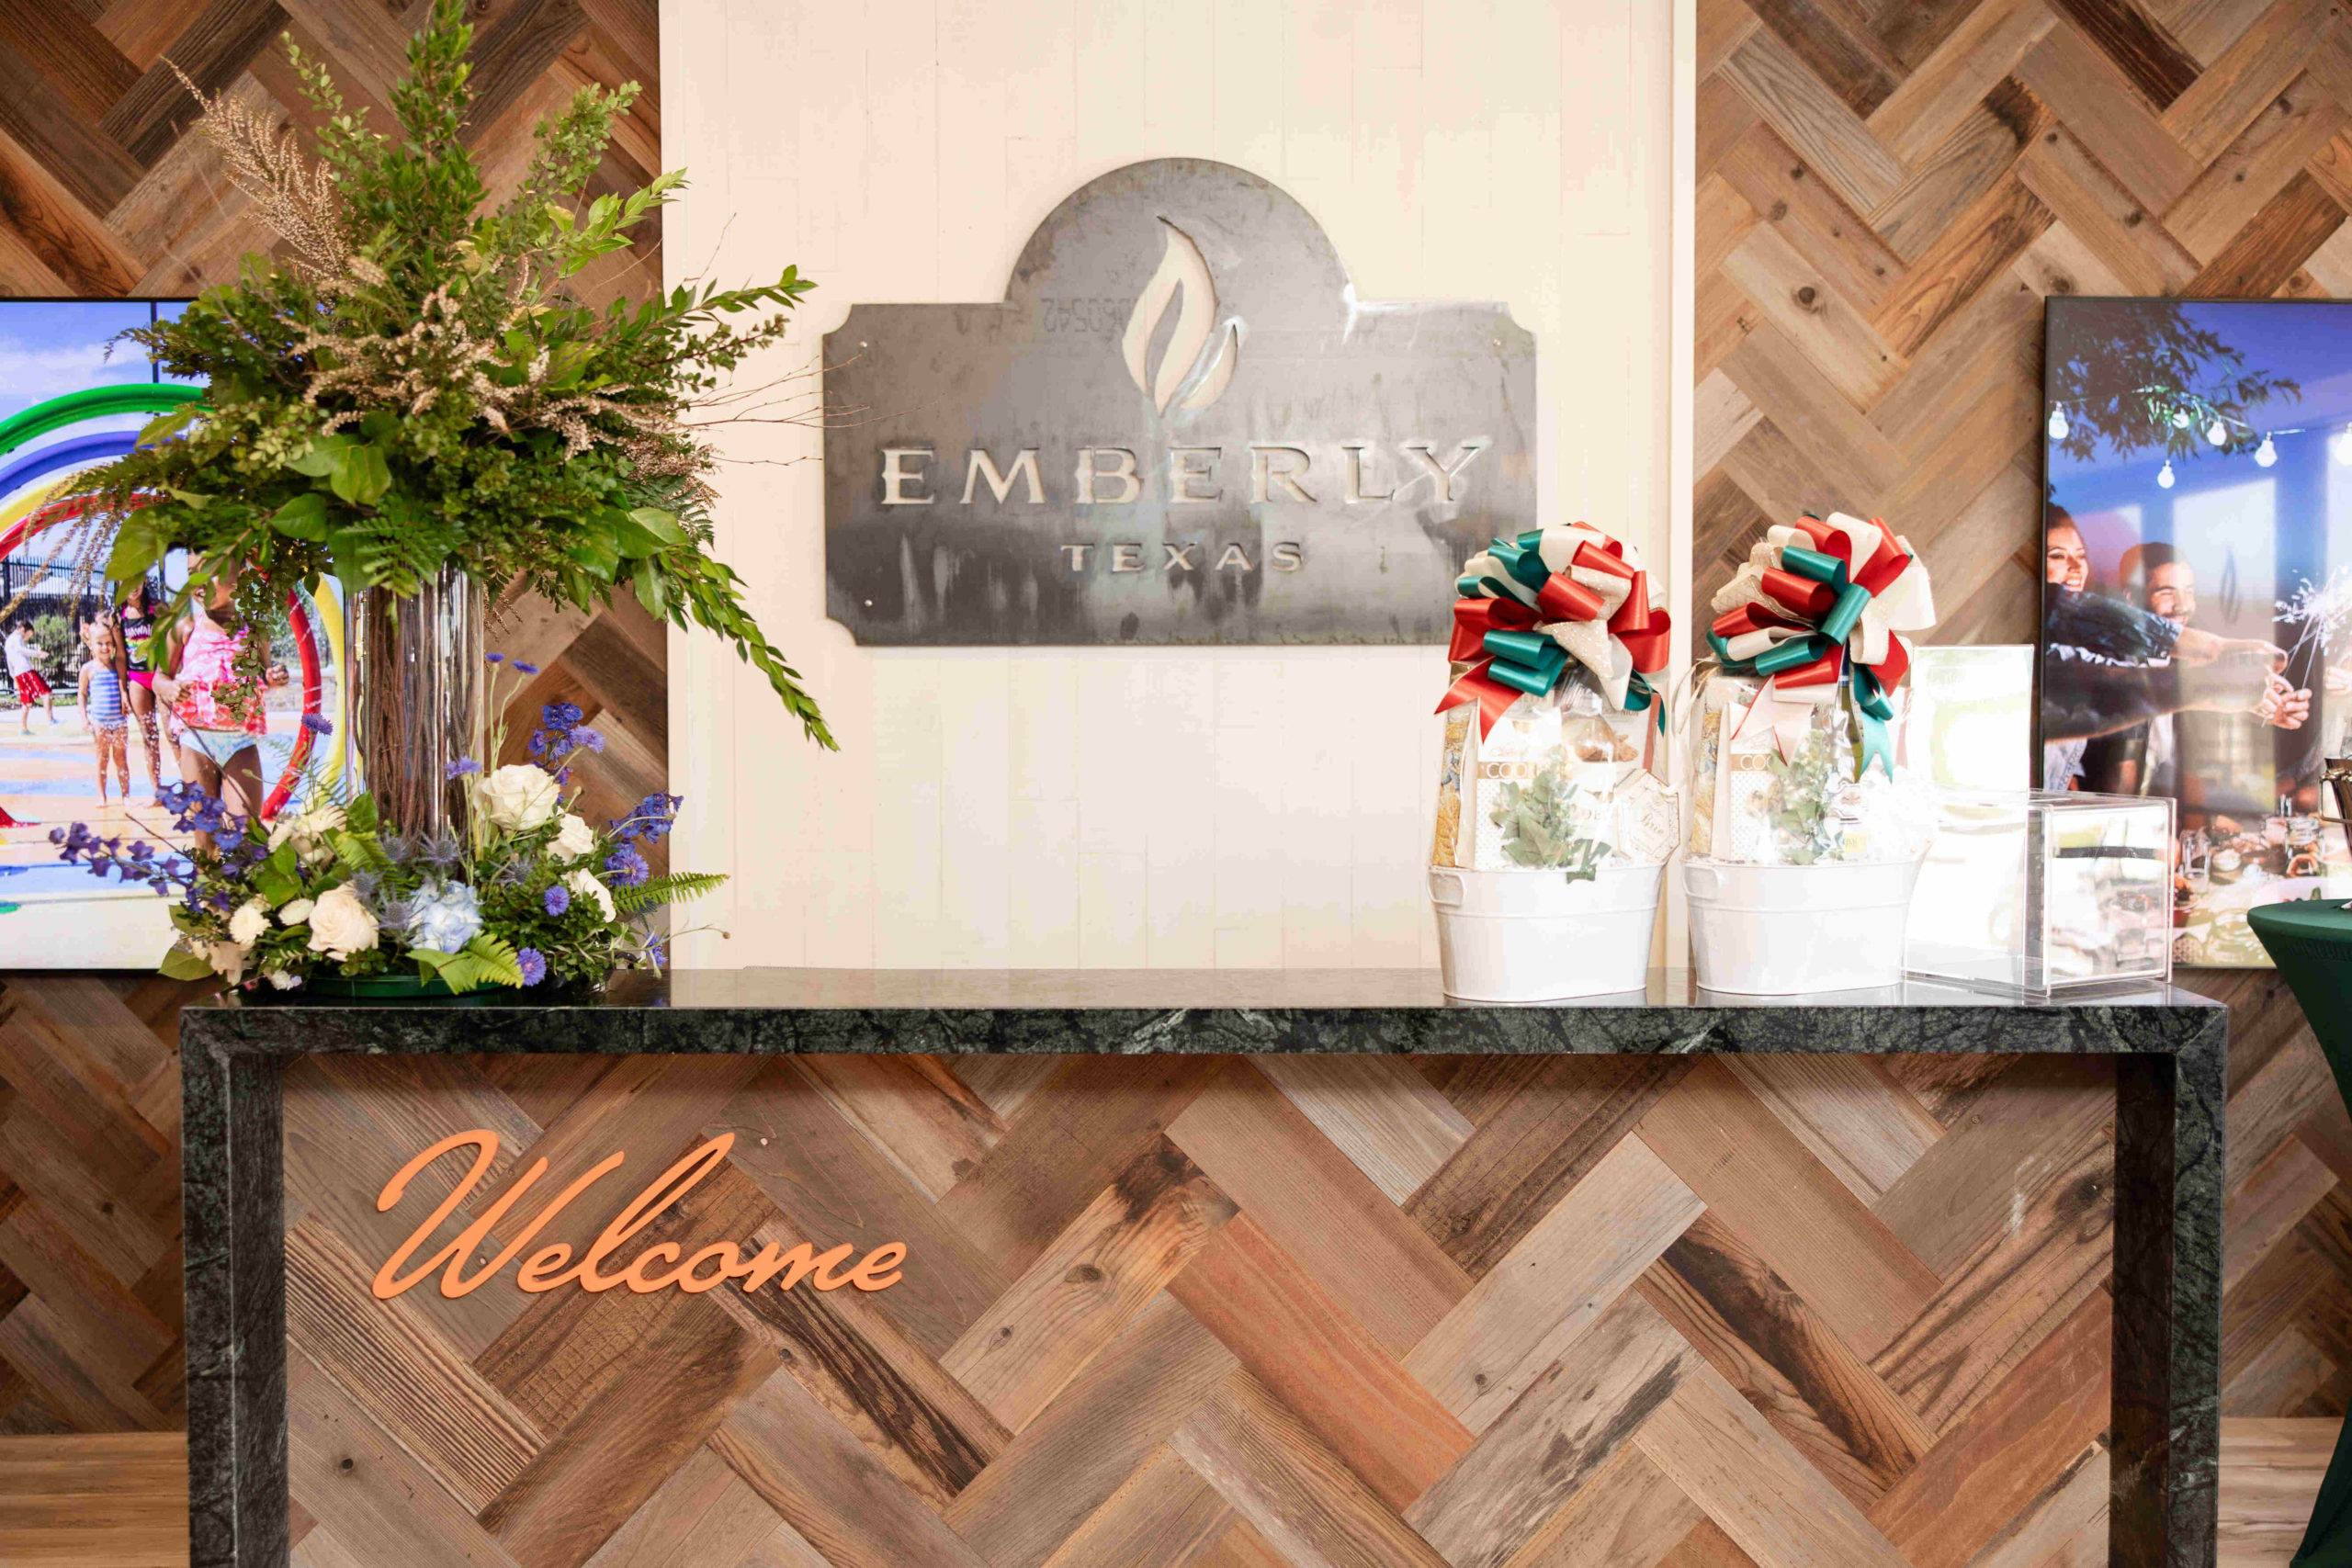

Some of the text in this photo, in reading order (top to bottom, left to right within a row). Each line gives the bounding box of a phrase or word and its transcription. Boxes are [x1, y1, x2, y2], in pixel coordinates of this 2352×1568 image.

[879, 445, 1490, 506] EMBERLY
[1060, 541, 1305, 572] TEXAS
[371, 1128, 908, 1300] Welcome
